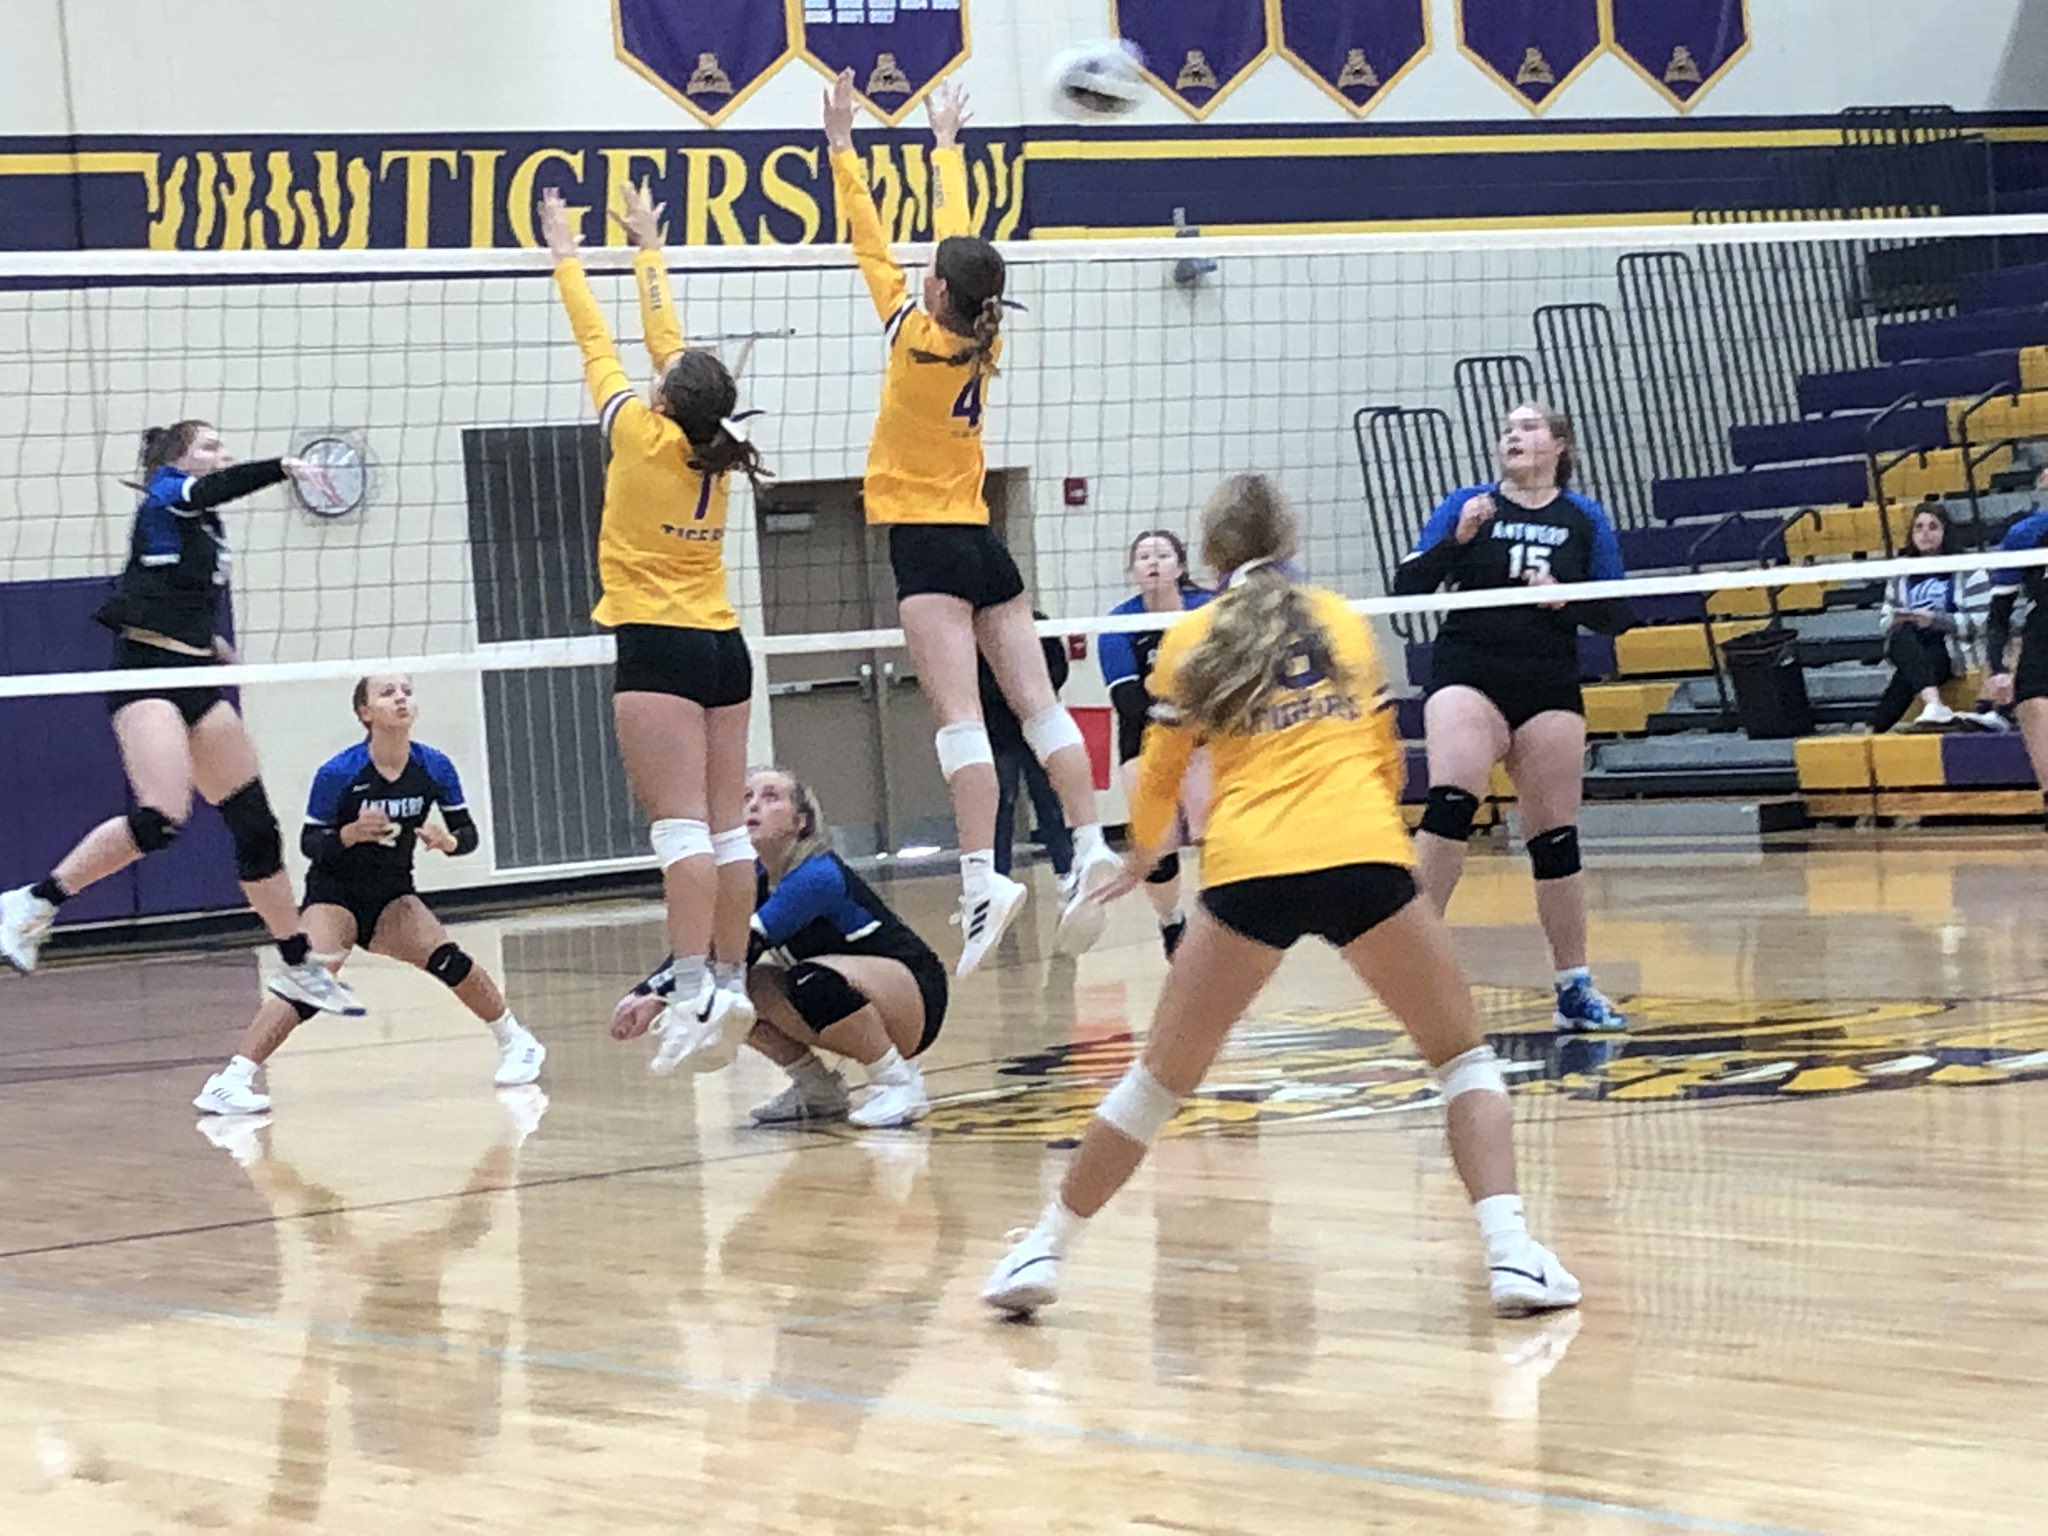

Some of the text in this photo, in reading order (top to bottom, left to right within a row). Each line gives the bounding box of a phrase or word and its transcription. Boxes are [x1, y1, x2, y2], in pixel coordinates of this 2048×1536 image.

[379, 145, 820, 249] TIGERS
[952, 366, 982, 428] 4
[1508, 543, 1552, 580] 15
